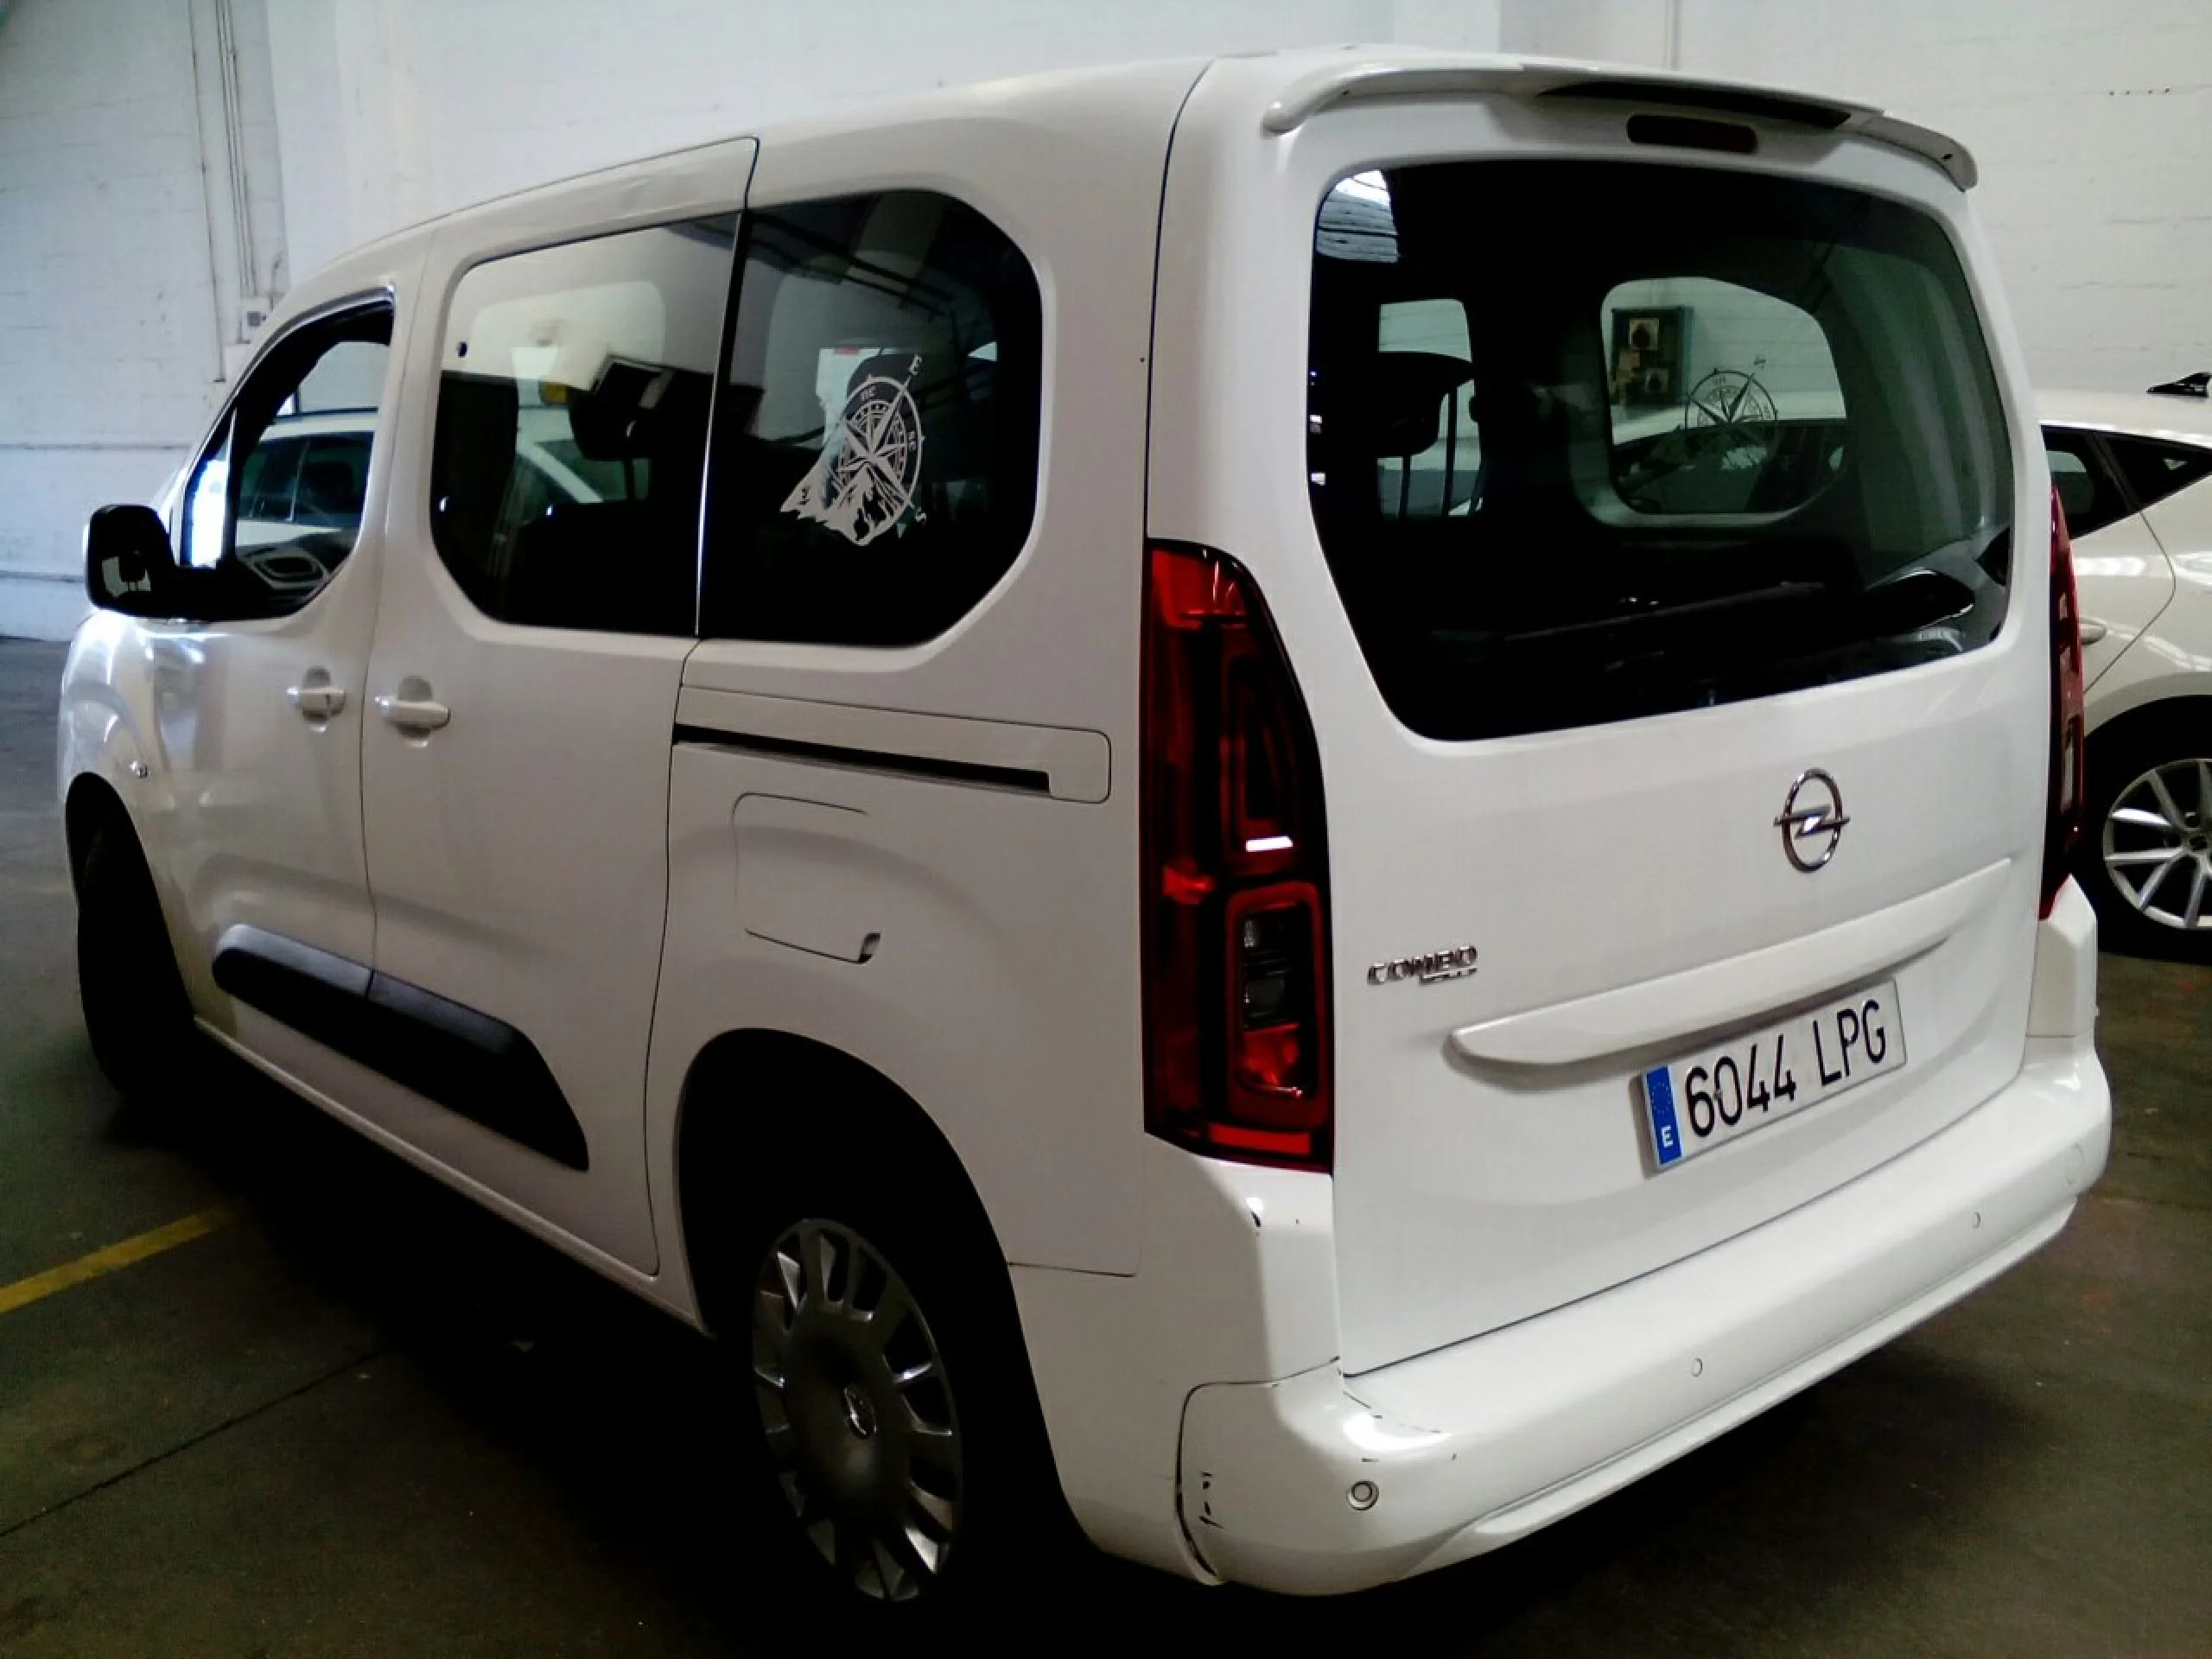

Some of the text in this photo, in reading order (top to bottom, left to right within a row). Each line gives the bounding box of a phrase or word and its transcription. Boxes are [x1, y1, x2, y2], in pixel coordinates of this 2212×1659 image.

[1367, 945, 1478, 986] COMBO
[1684, 999, 1886, 1139] 6044 LPG
[1660, 1125, 1674, 1147] E
